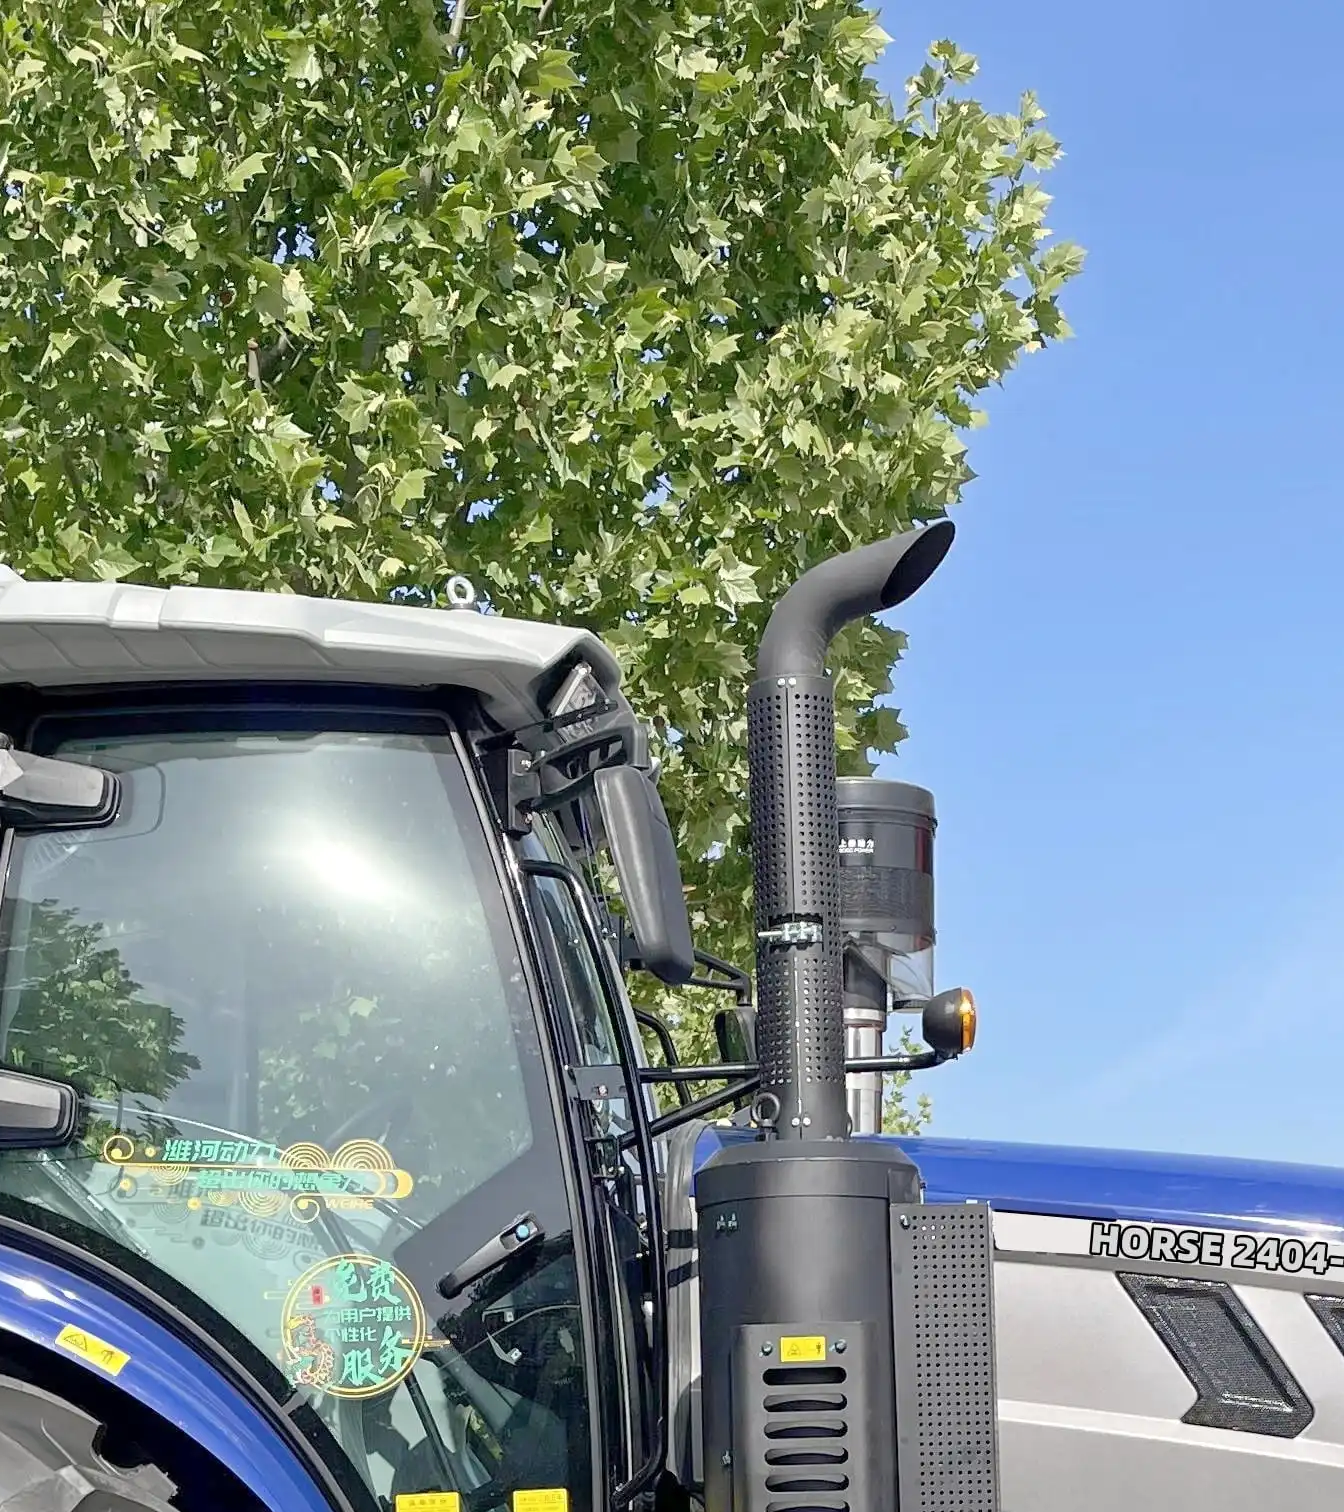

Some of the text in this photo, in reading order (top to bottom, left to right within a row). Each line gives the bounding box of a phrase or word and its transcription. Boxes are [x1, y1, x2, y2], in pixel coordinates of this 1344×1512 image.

[162, 1140, 279, 1162] 潍河动力
[1089, 1222, 1224, 1266] HORSE
[324, 1306, 412, 1323] 为用户提供
[324, 1326, 377, 1343] 个性化
[339, 1325, 416, 1386] 服务
